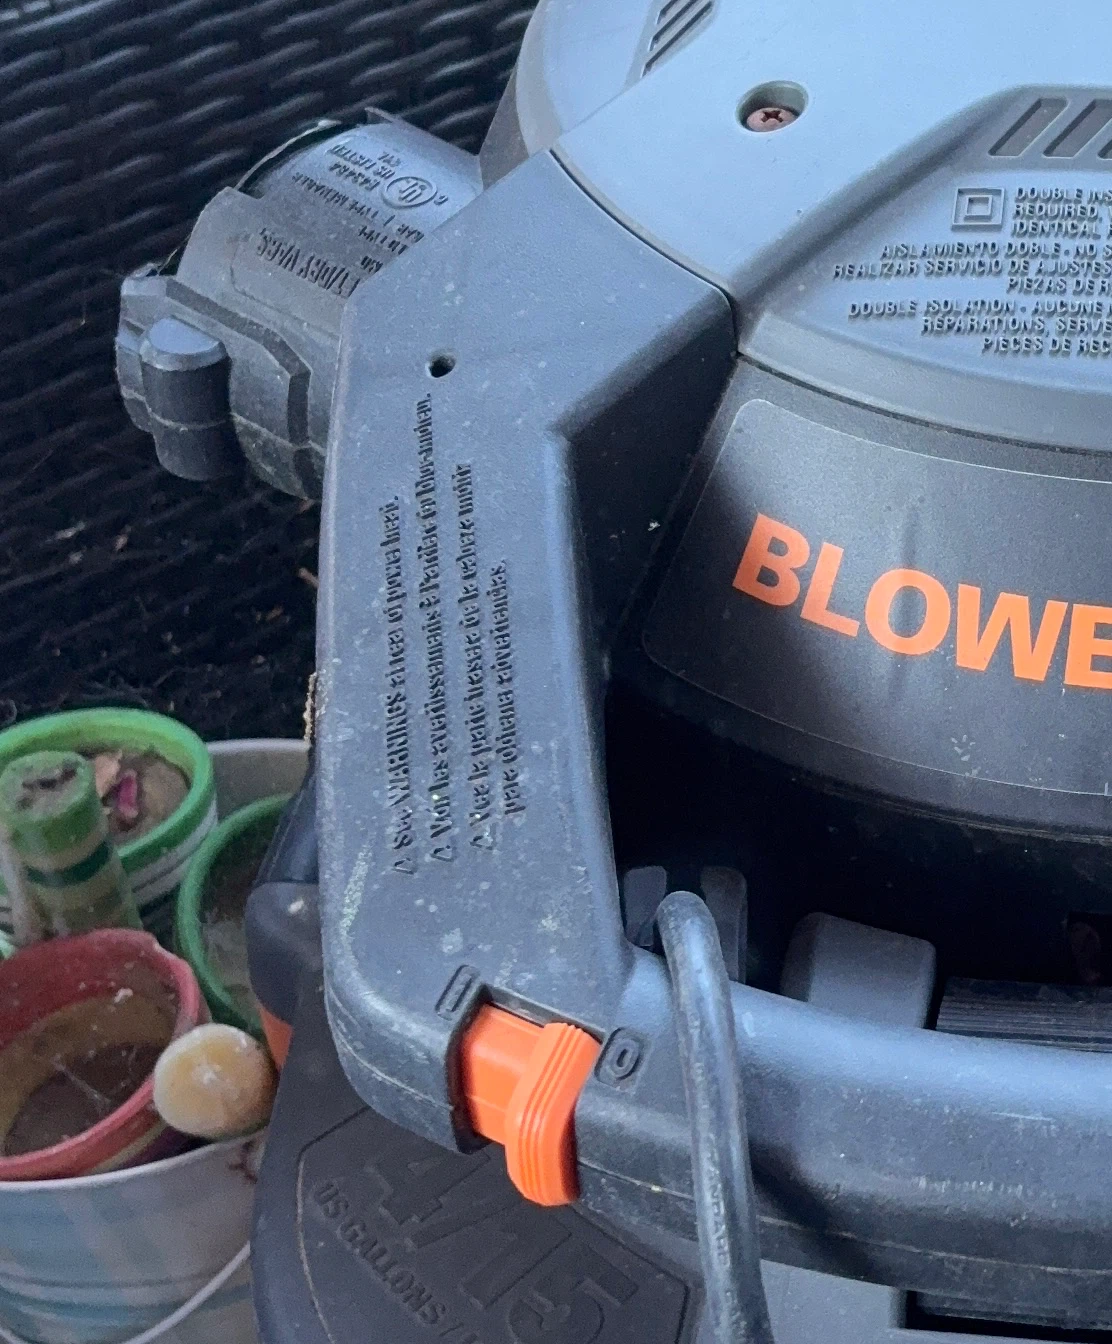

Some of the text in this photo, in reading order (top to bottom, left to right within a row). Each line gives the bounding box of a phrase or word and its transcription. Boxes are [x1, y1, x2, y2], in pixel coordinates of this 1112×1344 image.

[1015, 187, 1084, 204] DOUBLE
[1011, 220, 1101, 241] IDENTICAL
[880, 241, 999, 260] AISLAMIENTO
[1003, 242, 1062, 259] DOBLE
[1073, 244, 1098, 260] NO
[833, 260, 919, 281] REALIZAR
[923, 258, 1001, 278] SERVICIO
[1006, 259, 1031, 276] DE
[1034, 260, 1112, 277] AJUSTES
[1006, 276, 1067, 296] PIEZAS
[1071, 278, 1095, 296] DE
[848, 300, 918, 320] DOUBLE
[924, 299, 1017, 318] ISOLATION
[1031, 300, 1104, 317] AUCUNE
[1048, 336, 1072, 355] DE
[385, 691, 411, 807] WARNINGS
[314, 1180, 349, 1219] US
[336, 1218, 446, 1327] GALLONS
